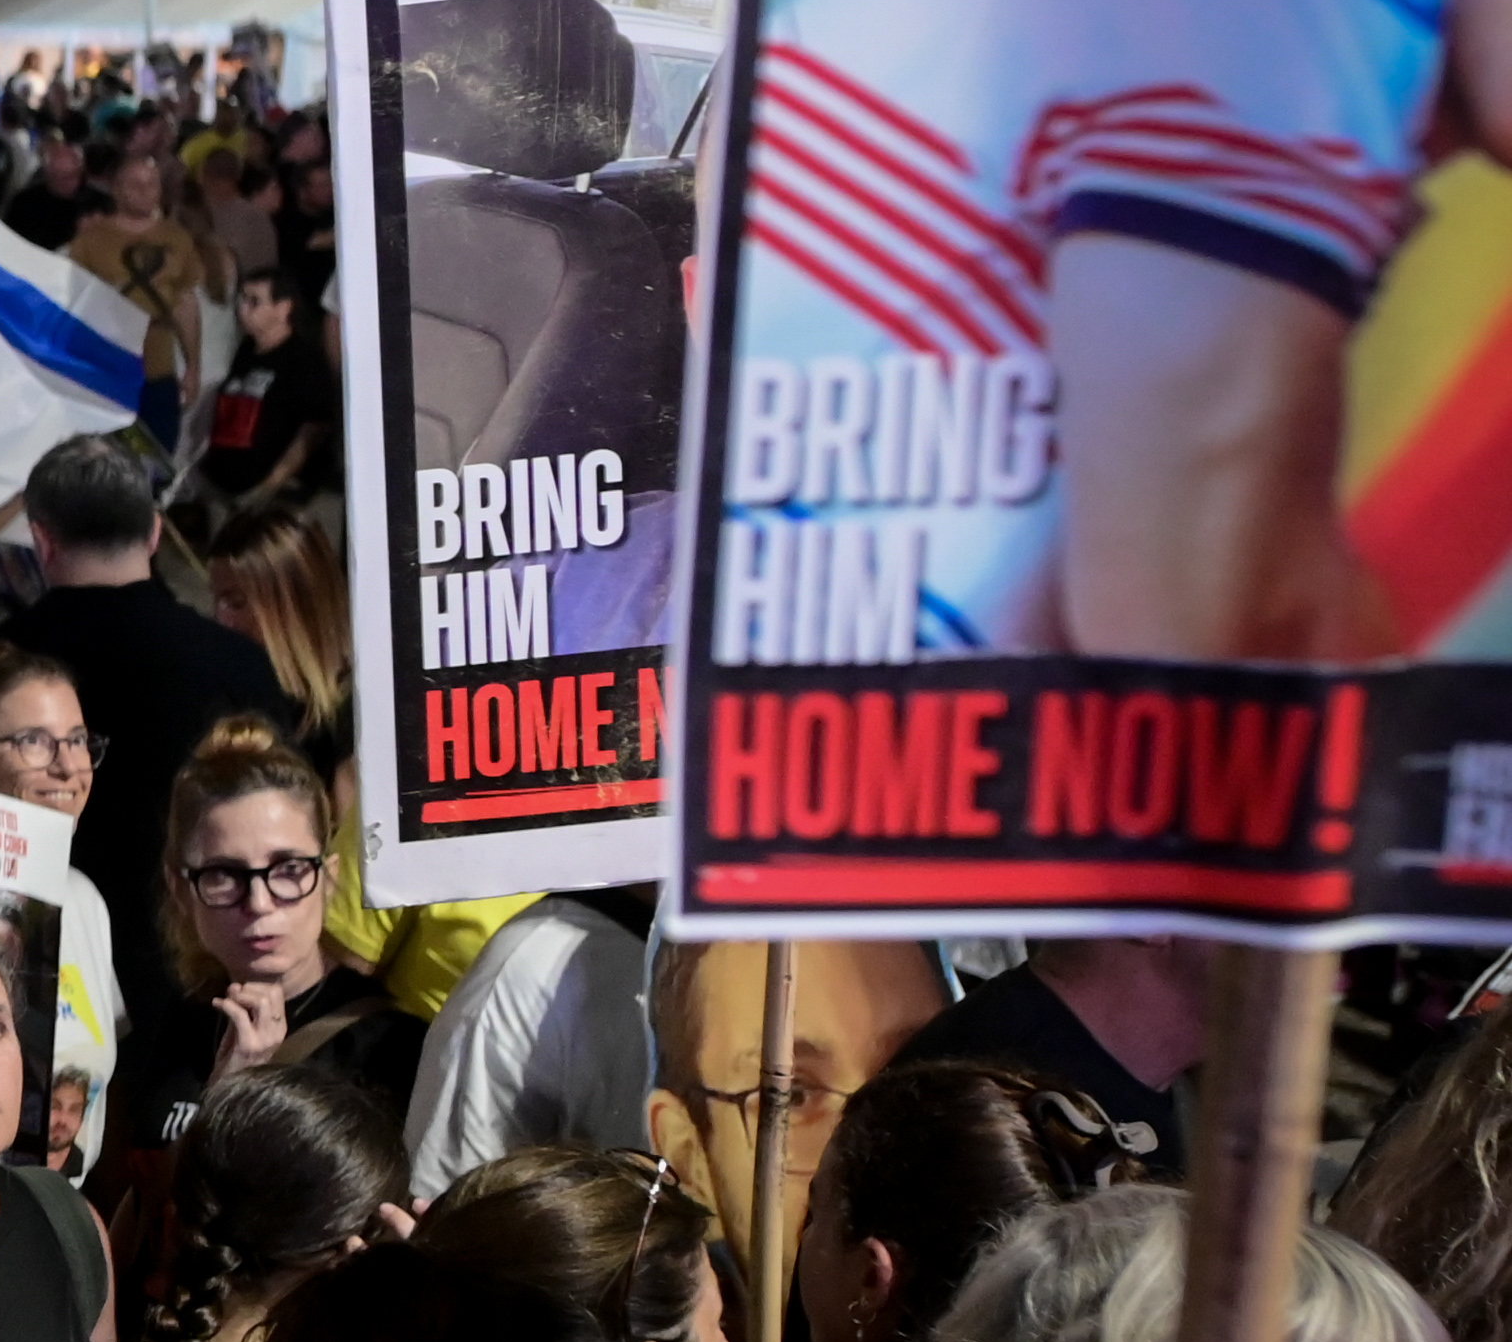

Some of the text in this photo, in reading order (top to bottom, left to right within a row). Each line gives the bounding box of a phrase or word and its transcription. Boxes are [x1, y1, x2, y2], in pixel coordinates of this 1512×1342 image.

[736, 358, 1059, 509] BRING
[415, 448, 625, 565] BRING
[419, 564, 550, 671] HIM
[714, 525, 924, 664] HIM
[425, 671, 617, 783] HOME
[707, 690, 1008, 838] HOME
[1028, 682, 1367, 853] NOW!
